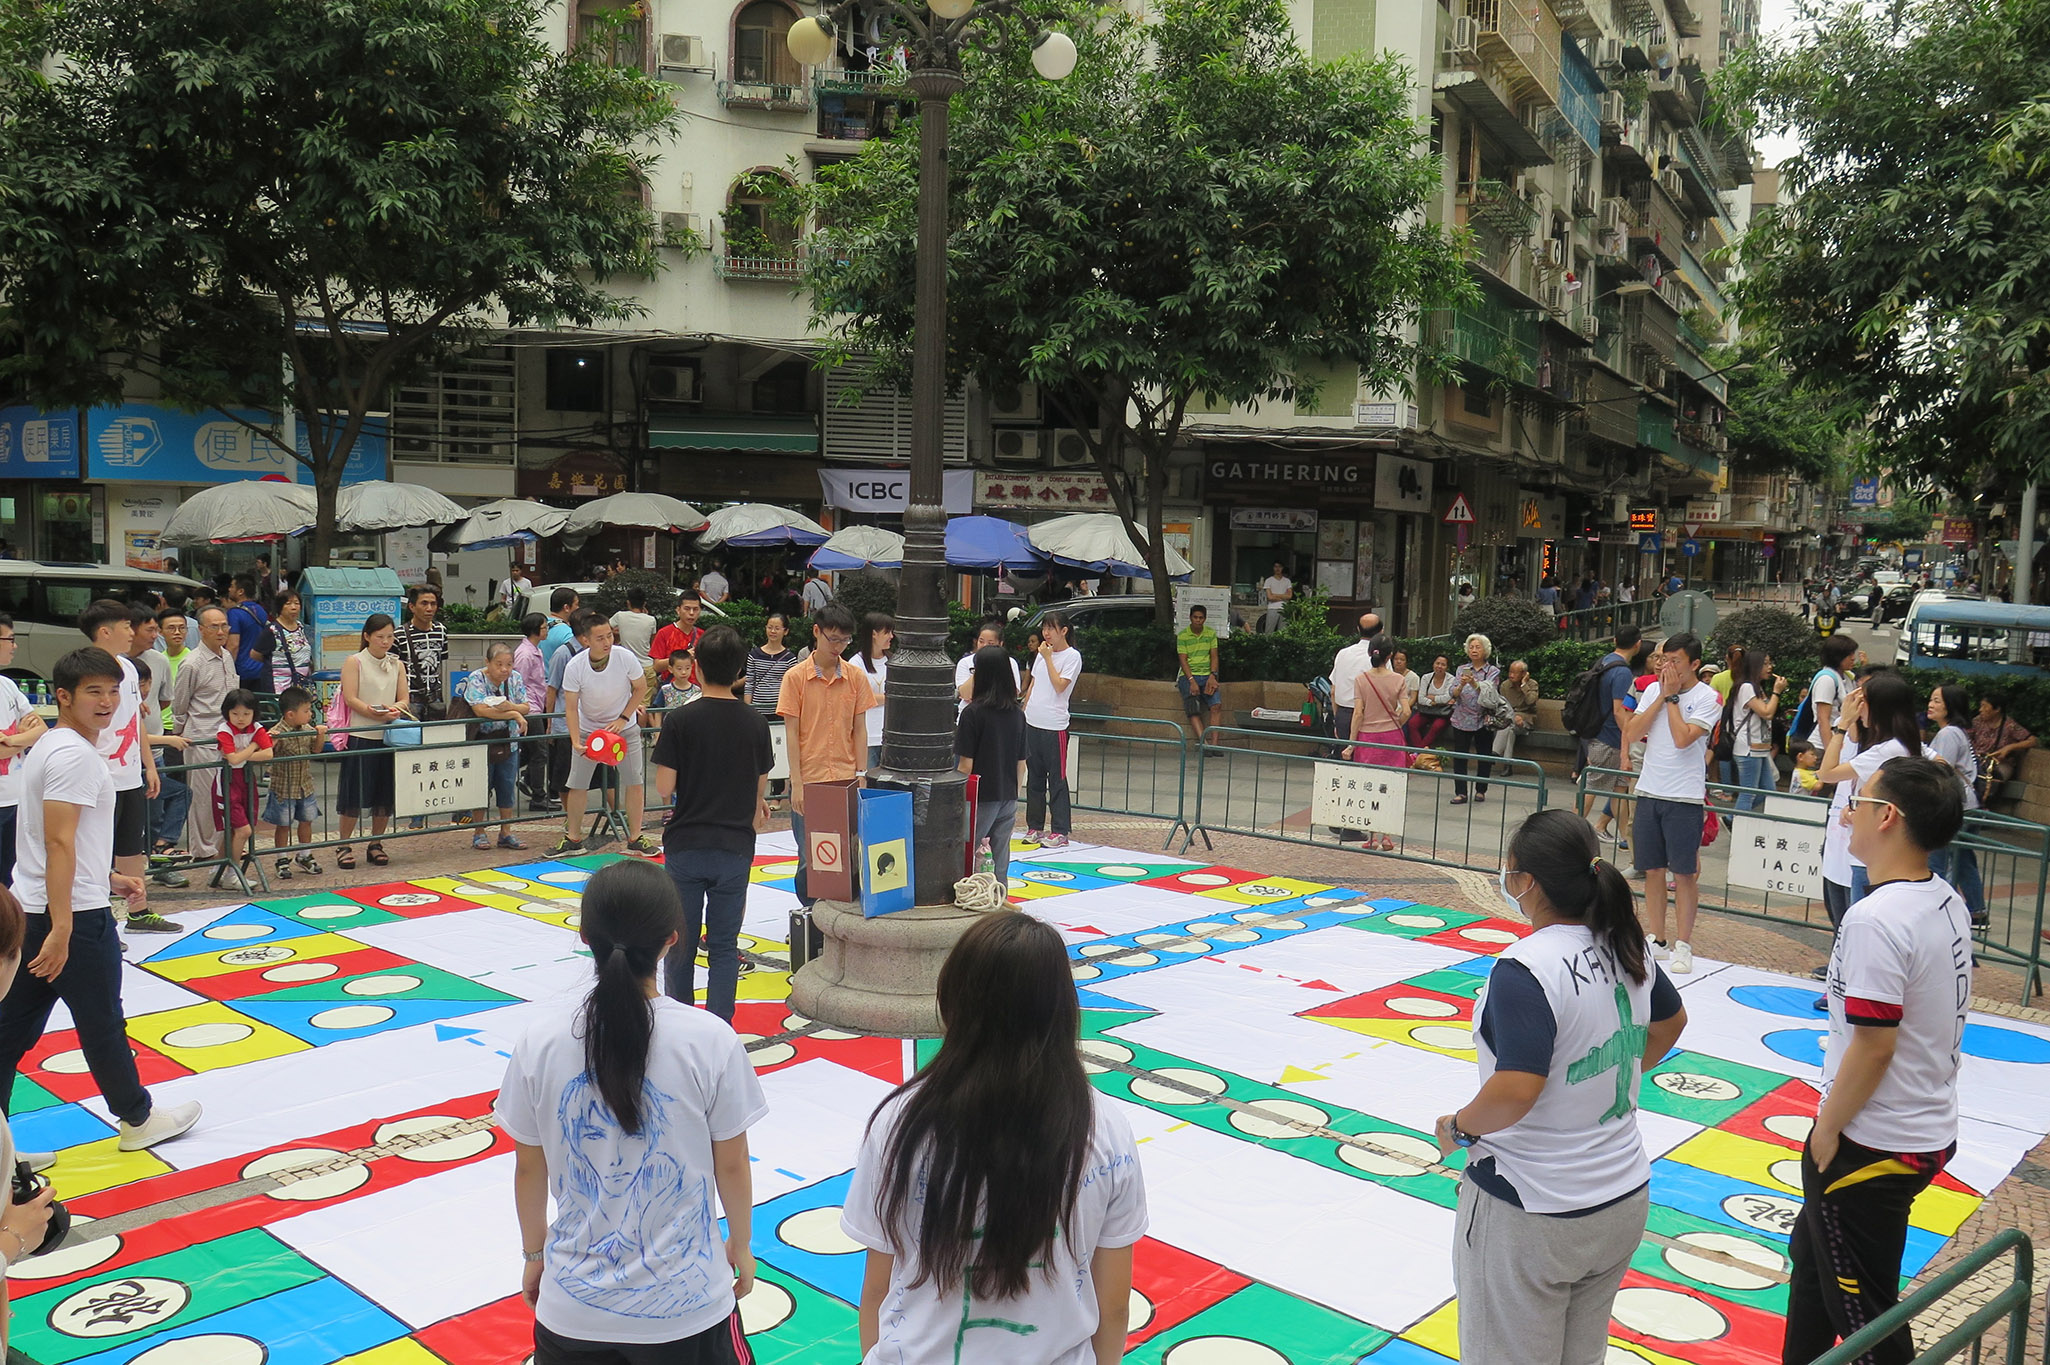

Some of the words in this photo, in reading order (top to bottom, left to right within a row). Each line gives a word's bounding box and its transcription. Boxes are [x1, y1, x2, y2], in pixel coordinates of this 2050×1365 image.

[124, 423, 134, 466] POPULAR
[1211, 462, 1359, 482] GATHERING
[849, 482, 903, 500] ICBC
[1855, 486, 1875, 494] Shell
[318, 600, 396, 614] 玻璃樽回收站
[411, 758, 471, 774] 民政總署
[419, 778, 464, 792] IACM
[1331, 778, 1388, 794] 民政總署
[1337, 797, 1380, 811] IACM
[1341, 815, 1371, 826] SCEU
[1762, 859, 1818, 877] IACM
[1767, 879, 1805, 894] SCEU
[1938, 895, 1969, 1088] TEDDY
